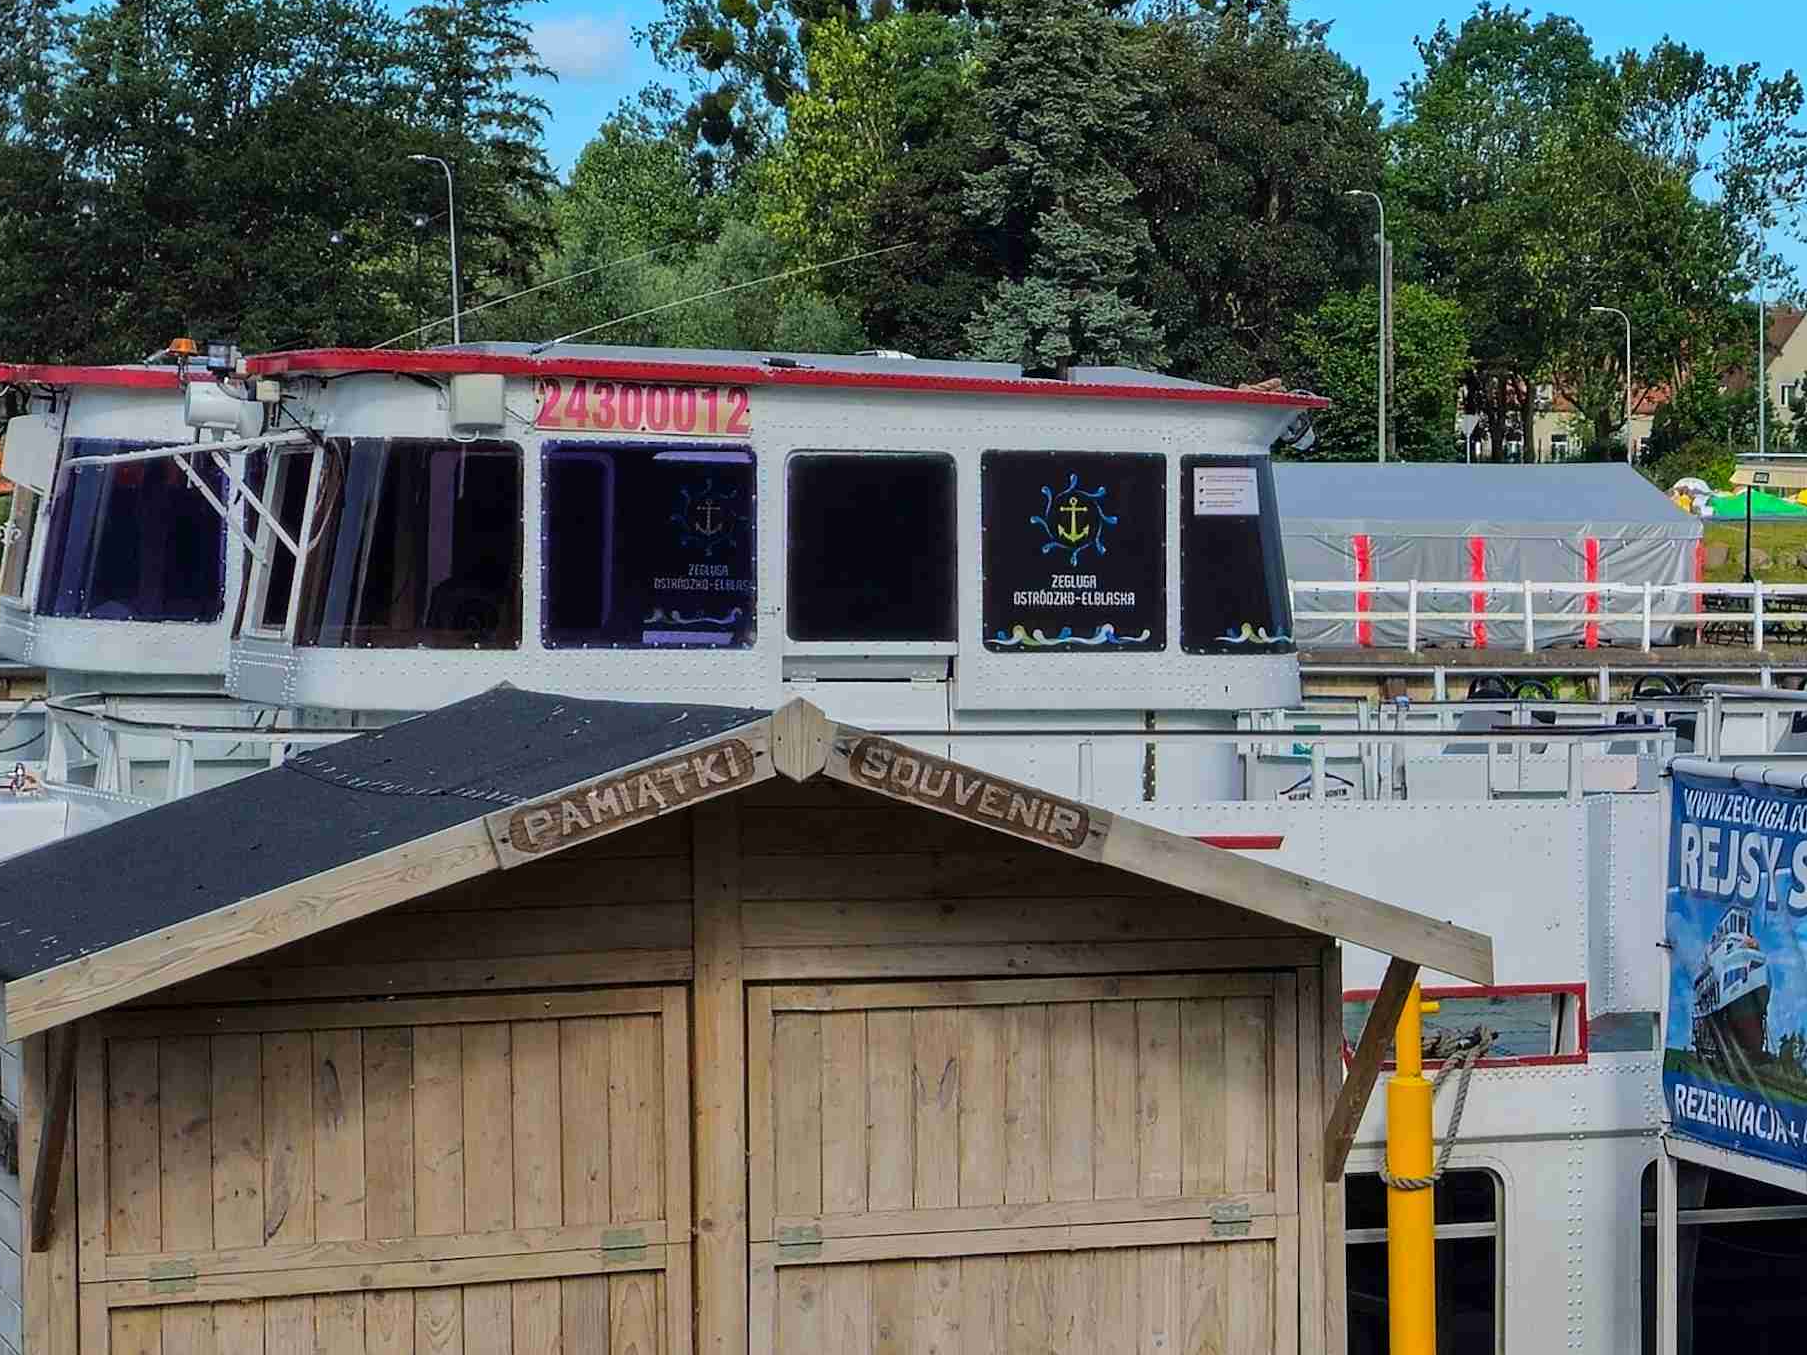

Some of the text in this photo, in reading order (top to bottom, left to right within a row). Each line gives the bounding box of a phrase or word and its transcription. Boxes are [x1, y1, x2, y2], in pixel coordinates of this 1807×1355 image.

[536, 378, 750, 434] 24300012
[860, 742, 1083, 841] SOUVENIR
[1680, 822, 1784, 902] REJSY
[1673, 1082, 1789, 1144] REZERWACJA
